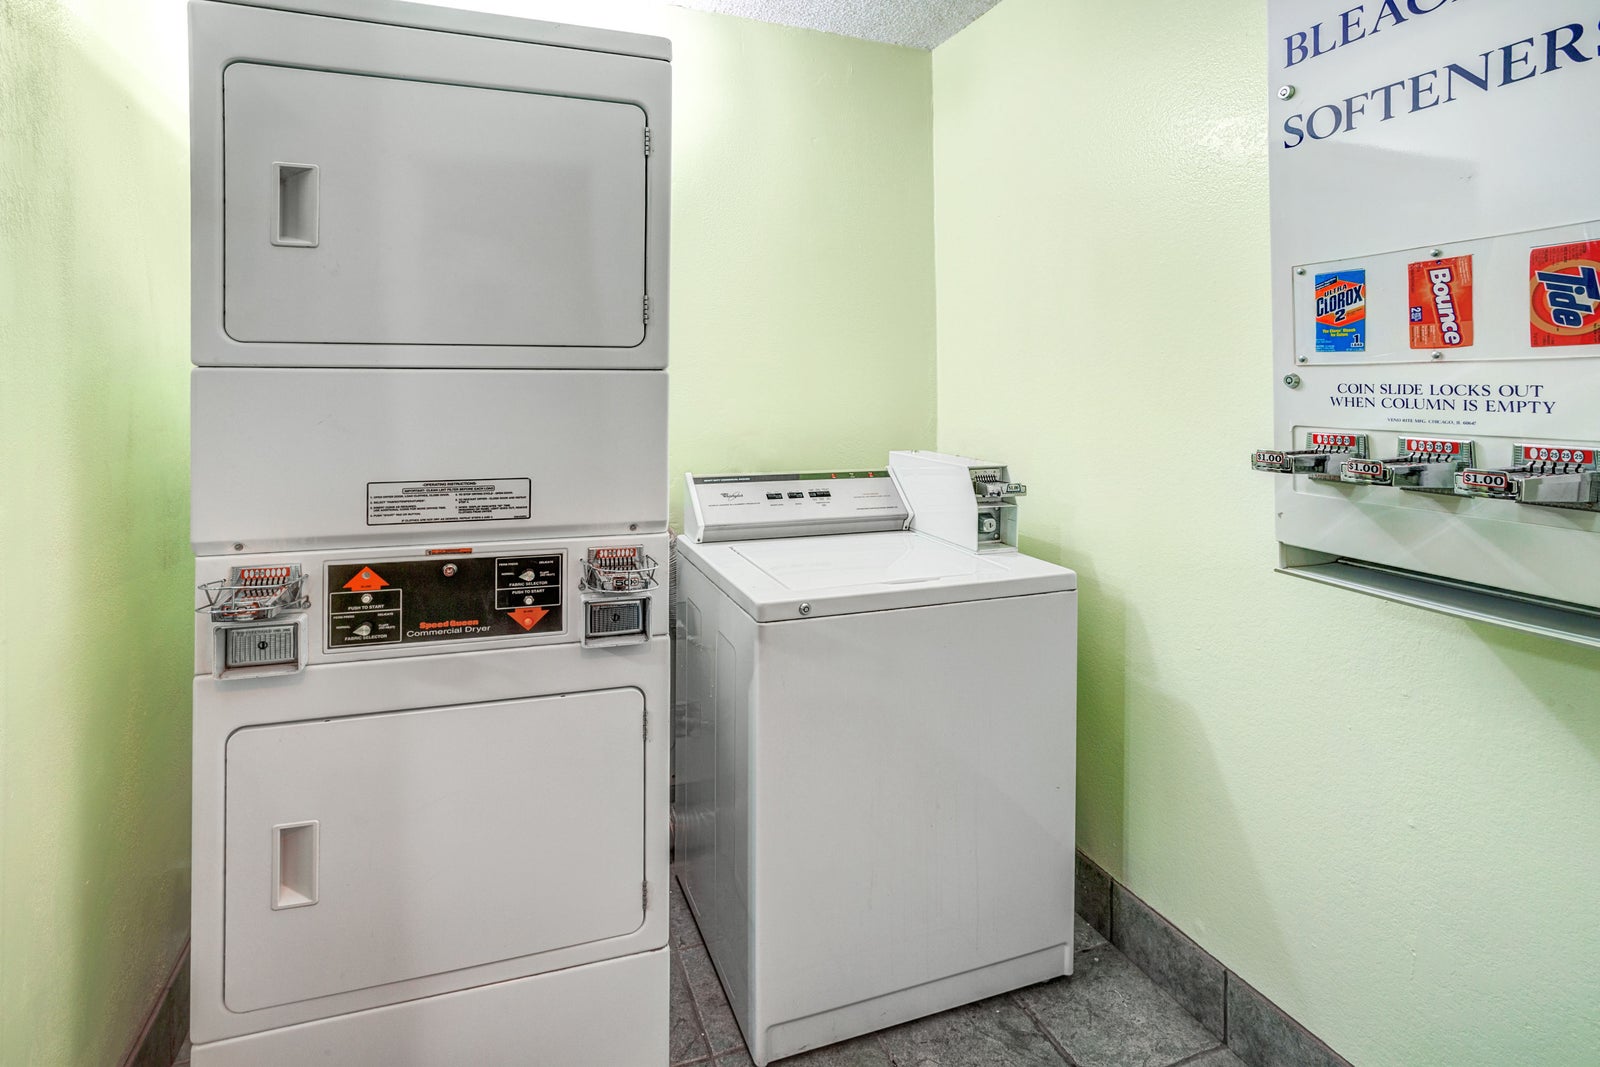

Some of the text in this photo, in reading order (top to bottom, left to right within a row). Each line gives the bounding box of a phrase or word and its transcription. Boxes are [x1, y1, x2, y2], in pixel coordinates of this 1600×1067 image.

[1284, 0, 1458, 68] BLEA
[1284, 19, 1600, 148] SOFTENER
[1324, 284, 1347, 297] ULTRA
[1535, 266, 1600, 328] Tide
[1316, 284, 1363, 317] CLOROX
[1429, 267, 1461, 345] Bounce
[1335, 308, 1346, 322] 2
[1353, 334, 1359, 343] 1
[1337, 383, 1544, 398] COIN SLIDE LOCKS OUT
[1330, 396, 1556, 414] WHEN COLUMN IS EMPTY
[1257, 453, 1282, 463] $1.00
[1348, 462, 1379, 474] $1.00
[1465, 474, 1504, 486] $1.00
[419, 619, 479, 629] Speed Queen
[406, 625, 491, 638] Commercial Dryer
